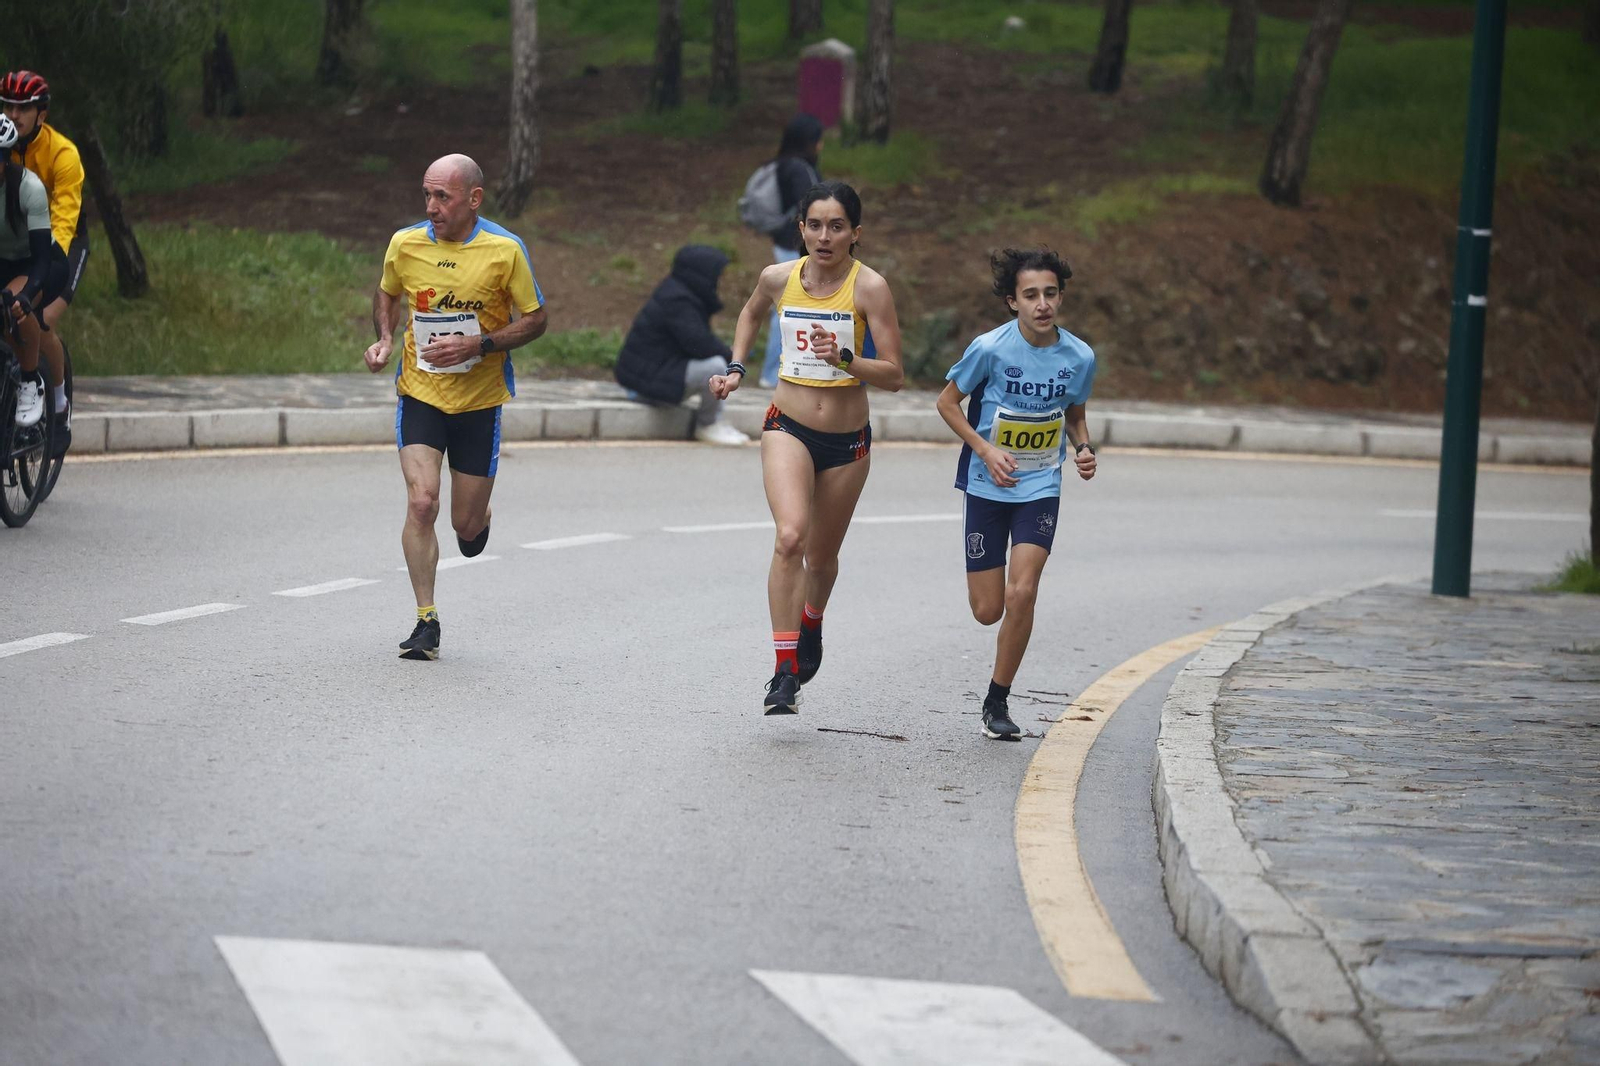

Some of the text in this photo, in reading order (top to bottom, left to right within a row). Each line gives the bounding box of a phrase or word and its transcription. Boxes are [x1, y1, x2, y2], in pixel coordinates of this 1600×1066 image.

[437, 259, 457, 269] vive
[437, 290, 484, 310] Álora
[1005, 378, 1067, 402] nerja
[1001, 428, 1058, 449] 1007
